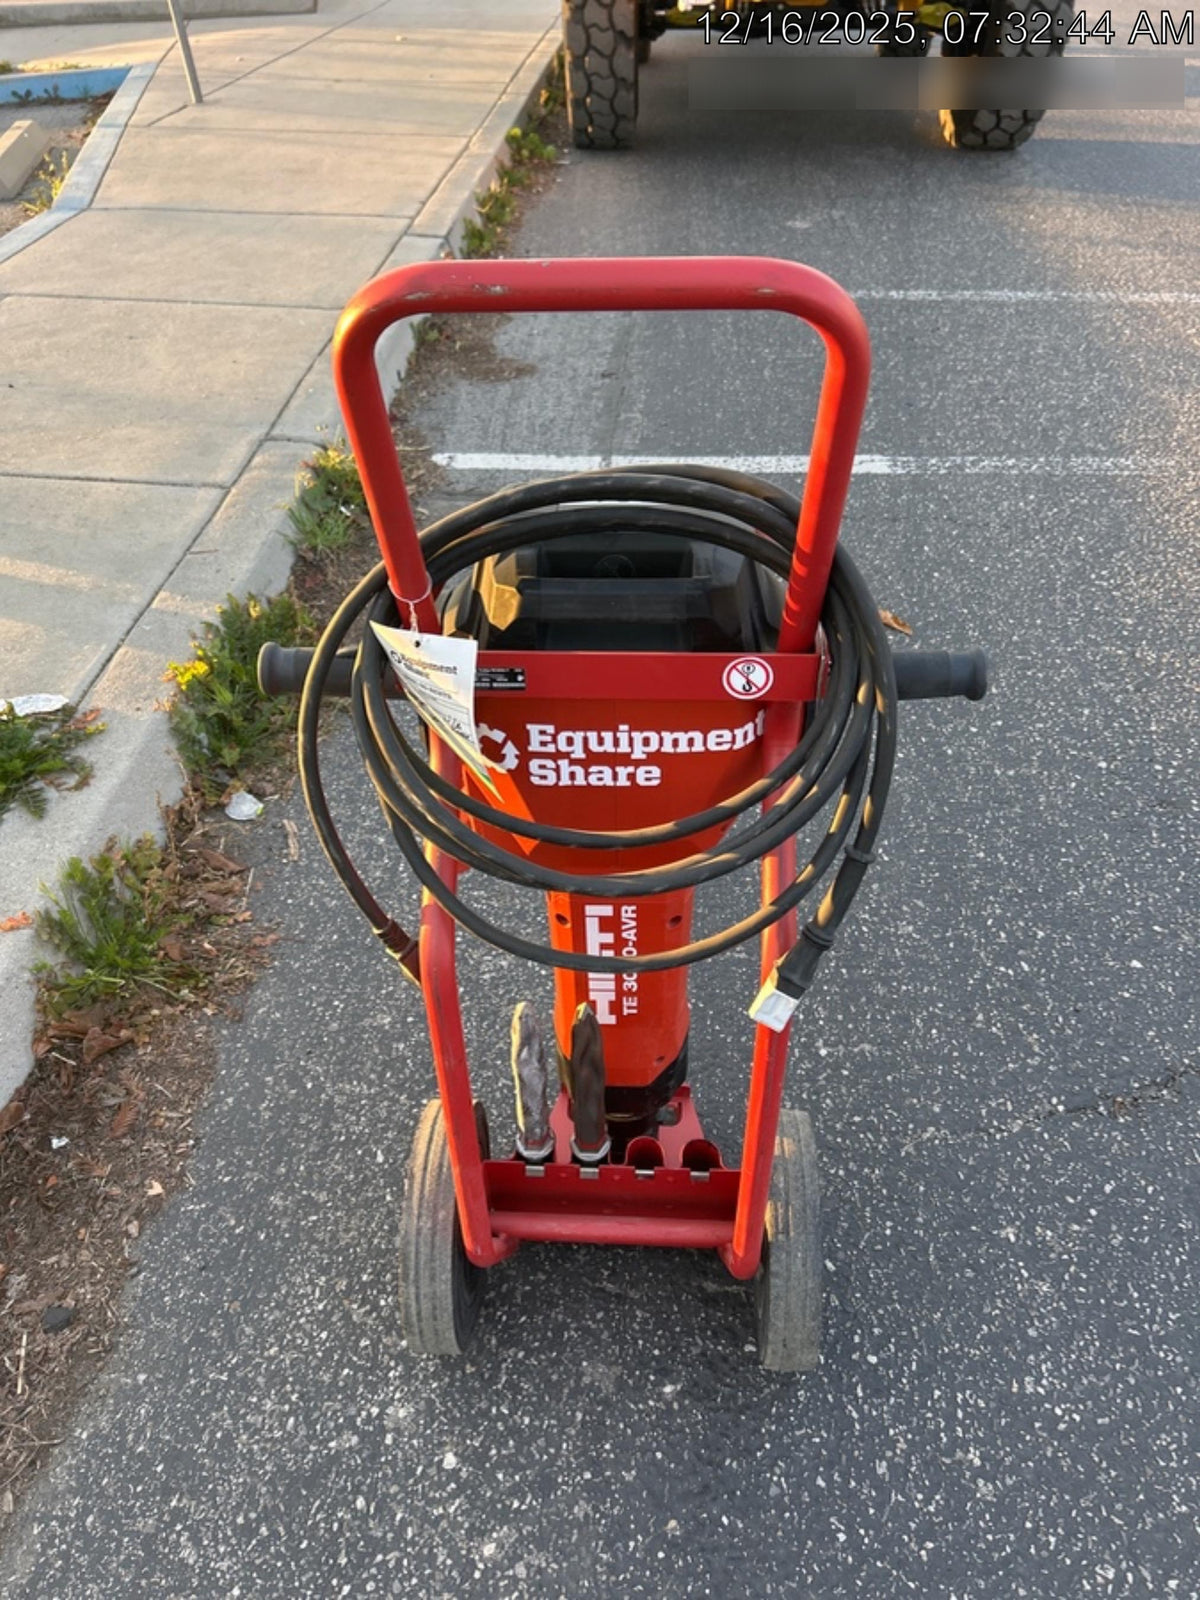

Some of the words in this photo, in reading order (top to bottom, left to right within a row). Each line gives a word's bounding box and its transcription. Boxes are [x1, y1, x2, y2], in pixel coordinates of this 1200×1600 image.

[526, 708, 766, 759] Equipment
[528, 759, 661, 787] Share
[621, 904, 638, 992] 300-AVR
[622, 995, 638, 1016] TE
